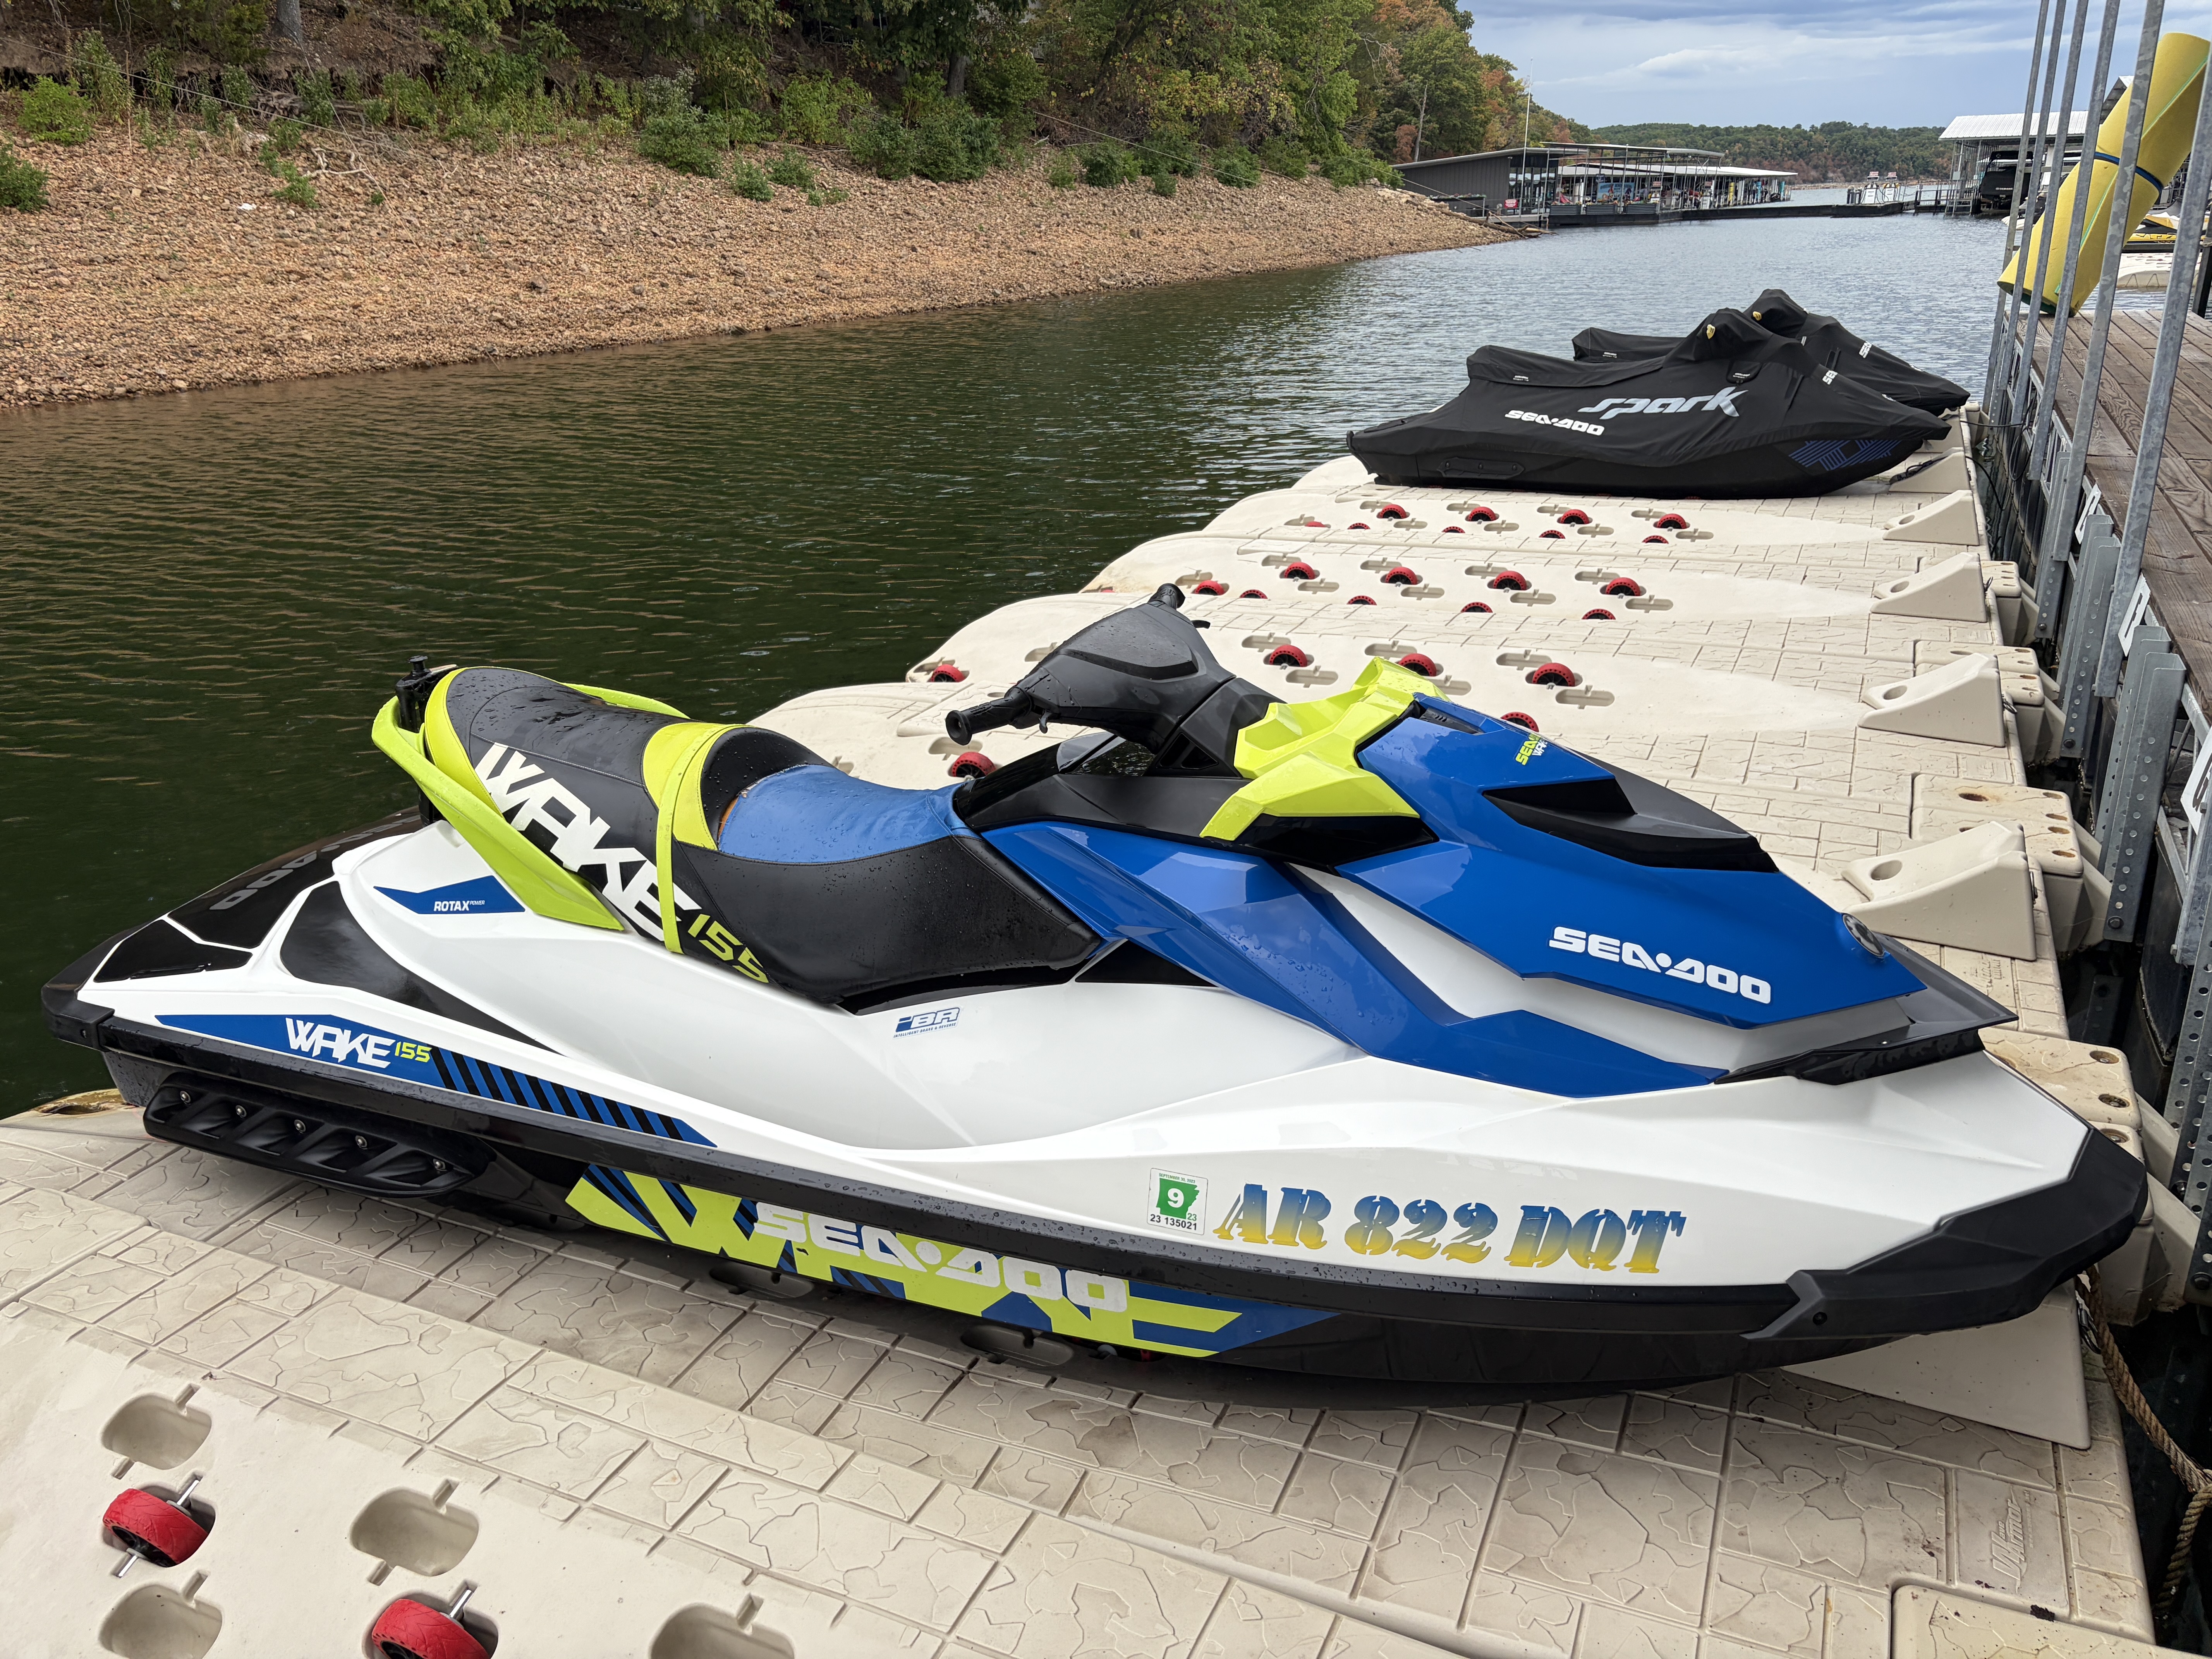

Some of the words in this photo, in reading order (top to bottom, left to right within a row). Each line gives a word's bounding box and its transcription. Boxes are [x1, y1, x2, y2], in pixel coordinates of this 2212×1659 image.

[474, 742, 702, 941] WAKE
[688, 914, 769, 984] 155
[434, 901, 470, 912] ROTAX
[285, 1017, 396, 1068] WAKE
[395, 1041, 432, 1063] 155
[893, 1030, 919, 1038] INTELLIGENT
[1168, 1188, 1184, 1208] 9
[1150, 1214, 1161, 1223] 23
[1164, 1217, 1197, 1231] 135021
[1187, 1212, 1197, 1221] 23
[1212, 1183, 1331, 1249] AR
[1345, 1195, 1498, 1264] 822
[1504, 1205, 1686, 1274] DQT
